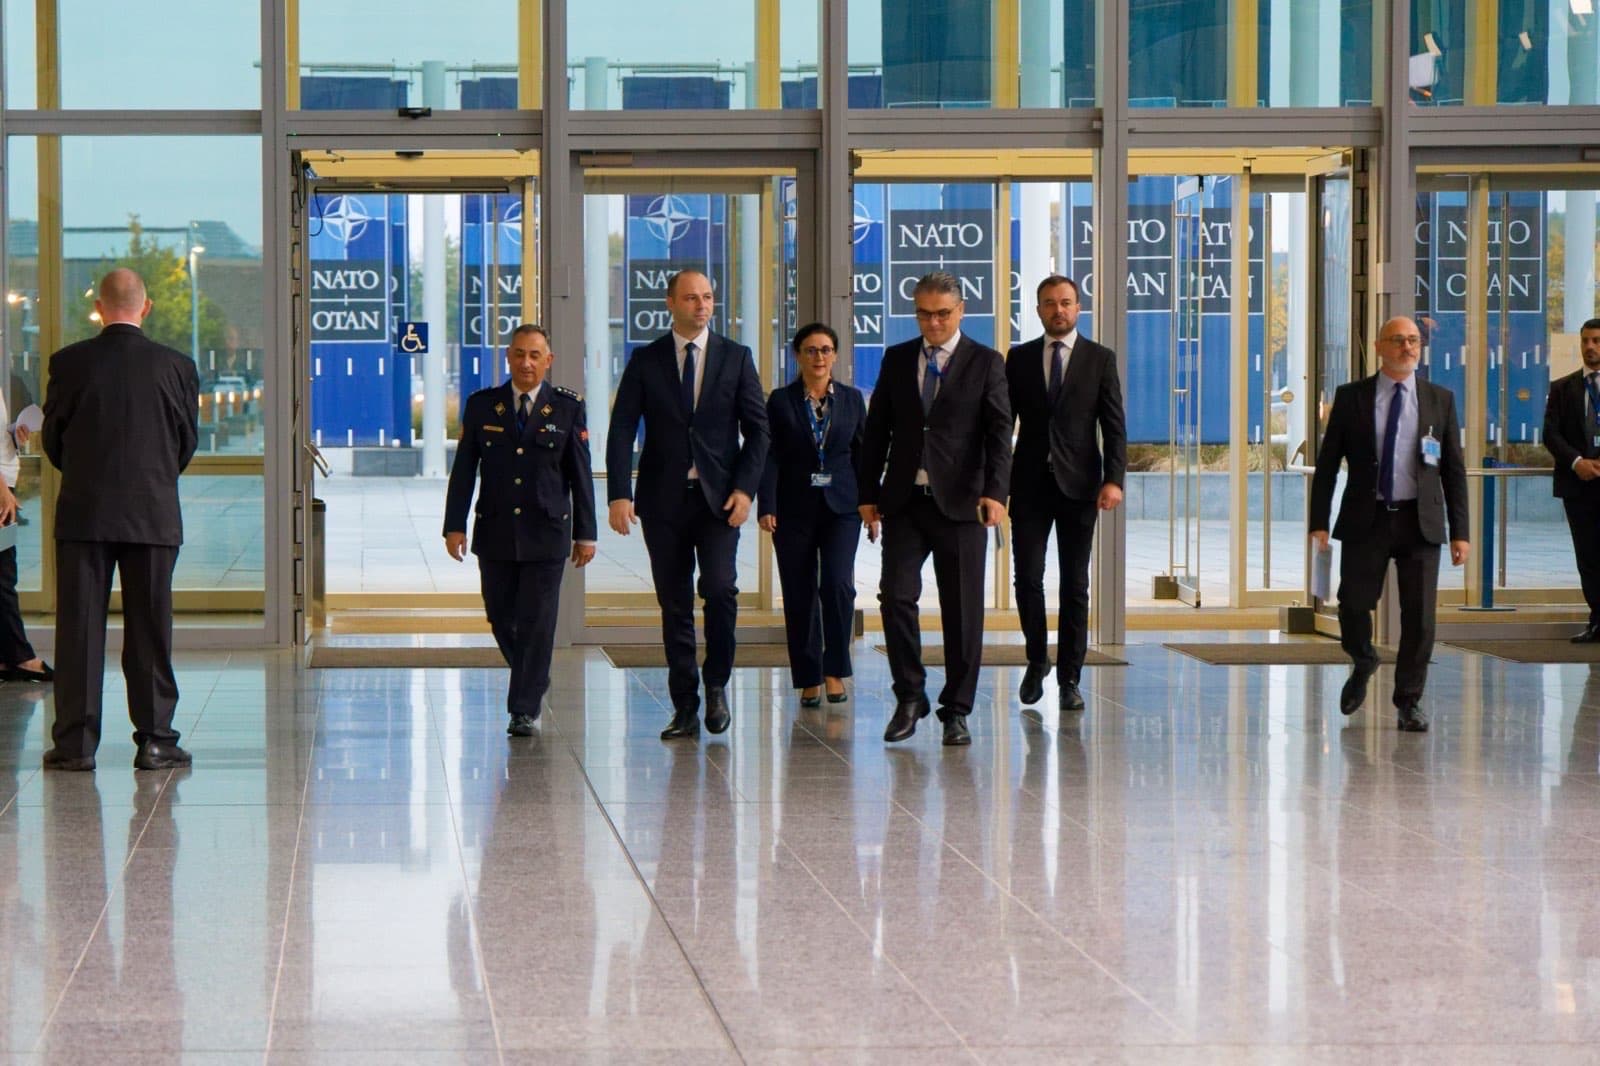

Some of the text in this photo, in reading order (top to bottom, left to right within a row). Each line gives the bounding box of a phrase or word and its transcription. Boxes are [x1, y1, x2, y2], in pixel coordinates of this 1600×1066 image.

[899, 223, 983, 248] NATO
[1446, 220, 1531, 245] NTO
[312, 270, 380, 290] NATO
[899, 276, 985, 301] ON
[1446, 273, 1532, 297] OAN
[312, 311, 380, 332] OTAN
